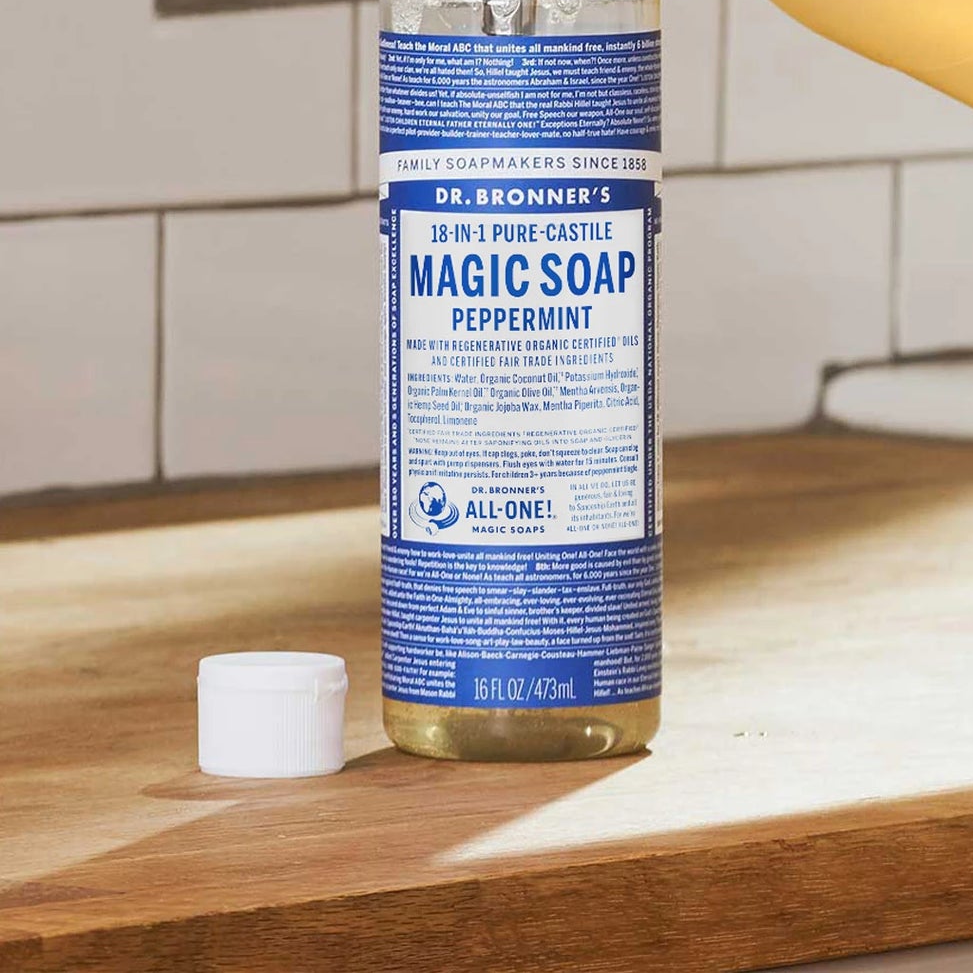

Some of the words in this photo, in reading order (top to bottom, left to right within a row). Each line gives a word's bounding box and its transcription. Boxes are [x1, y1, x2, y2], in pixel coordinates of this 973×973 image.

[415, 41, 427, 52] the
[427, 42, 451, 52] Moral
[452, 43, 471, 53] ABC
[473, 43, 494, 53] that
[496, 43, 526, 53] unites
[528, 43, 541, 53] all
[543, 42, 583, 53] mankind
[606, 40, 635, 52] instantly
[483, 58, 514, 68] Nothing!
[544, 58, 556, 66] not
[505, 68, 529, 78] taught
[581, 67, 599, 75] teach
[451, 78, 469, 86] years
[483, 78, 529, 86] astronomers
[530, 77, 562, 86] Abraham
[563, 77, 569, 85] &
[591, 76, 607, 84] since
[554, 100, 574, 108] Rabbi
[471, 110, 489, 120] unity
[523, 110, 539, 119] Free
[540, 110, 565, 120] Speech
[446, 120, 472, 128] FATHER
[540, 120, 578, 129] Exceptions
[397, 158, 440, 172] FAMILY
[446, 157, 566, 171] SOAPMAKERS
[572, 157, 619, 170] SINCE
[622, 157, 648, 171] 1858
[435, 186, 472, 206] DR.
[476, 186, 611, 206] BRONNER'S
[430, 223, 487, 243] 18-IN-1
[492, 221, 614, 243] PURE-CASTILE
[409, 253, 530, 298] MAGIC
[539, 250, 636, 297] SOAP
[452, 305, 593, 332] PEPPERMINT
[406, 339, 427, 351] MADE
[429, 339, 450, 351] WITH
[452, 340, 523, 352] REGENERATIVE
[525, 338, 569, 352] ORGANIC
[622, 335, 639, 347] OILS
[431, 355, 448, 367] AND
[449, 356, 496, 368] CERTIFIED
[499, 355, 520, 368] FAIR
[522, 355, 552, 368] TRADE
[555, 352, 614, 366] INGREDIENTS
[480, 373, 511, 385] Organic
[512, 373, 546, 384] Coconut
[565, 371, 605, 382] Potassium
[490, 387, 521, 400] Organic
[521, 387, 541, 398] Olive
[559, 386, 588, 397] Mentha
[432, 400, 450, 410] Seed
[464, 401, 494, 414] Organic
[495, 402, 521, 414] Jojoba
[543, 400, 573, 411] Mentha
[502, 460, 521, 468] Flush
[471, 486, 488, 495] DR.
[489, 486, 546, 495] BRONNER'S
[465, 499, 553, 520] ALL-ONE!
[471, 525, 506, 535] MAGIC
[510, 525, 546, 535] SOAPS
[485, 552, 516, 561] mankind
[473, 677, 488, 700] 16
[491, 677, 505, 701] FL
